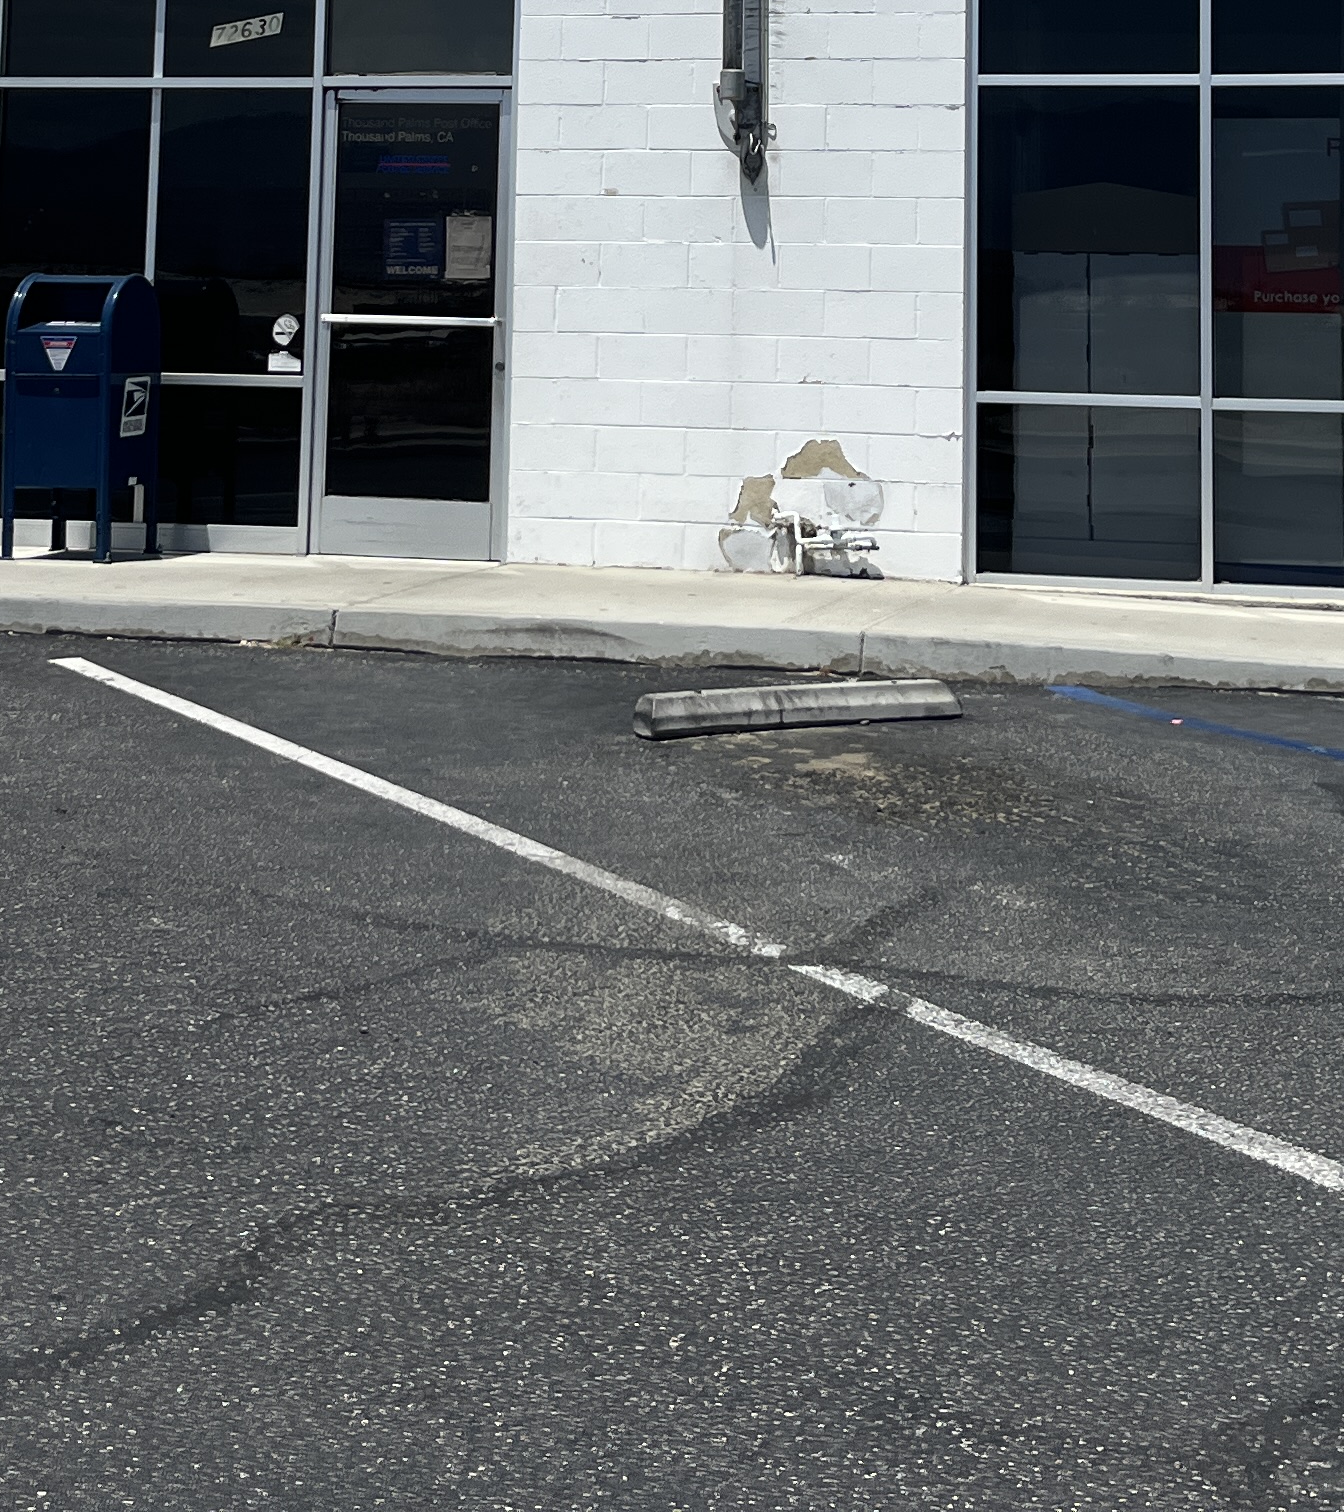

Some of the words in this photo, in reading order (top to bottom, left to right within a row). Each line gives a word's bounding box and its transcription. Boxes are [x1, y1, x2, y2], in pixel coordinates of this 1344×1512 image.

[214, 15, 281, 42] 72630
[342, 117, 395, 129] Thousand
[397, 118, 431, 129] Palms
[433, 118, 458, 129] Post
[460, 118, 492, 129] Office
[398, 131, 433, 144] Palms,
[437, 131, 454, 143] CA
[385, 265, 439, 275] WELCOME
[1253, 290, 1318, 303] Purchase
